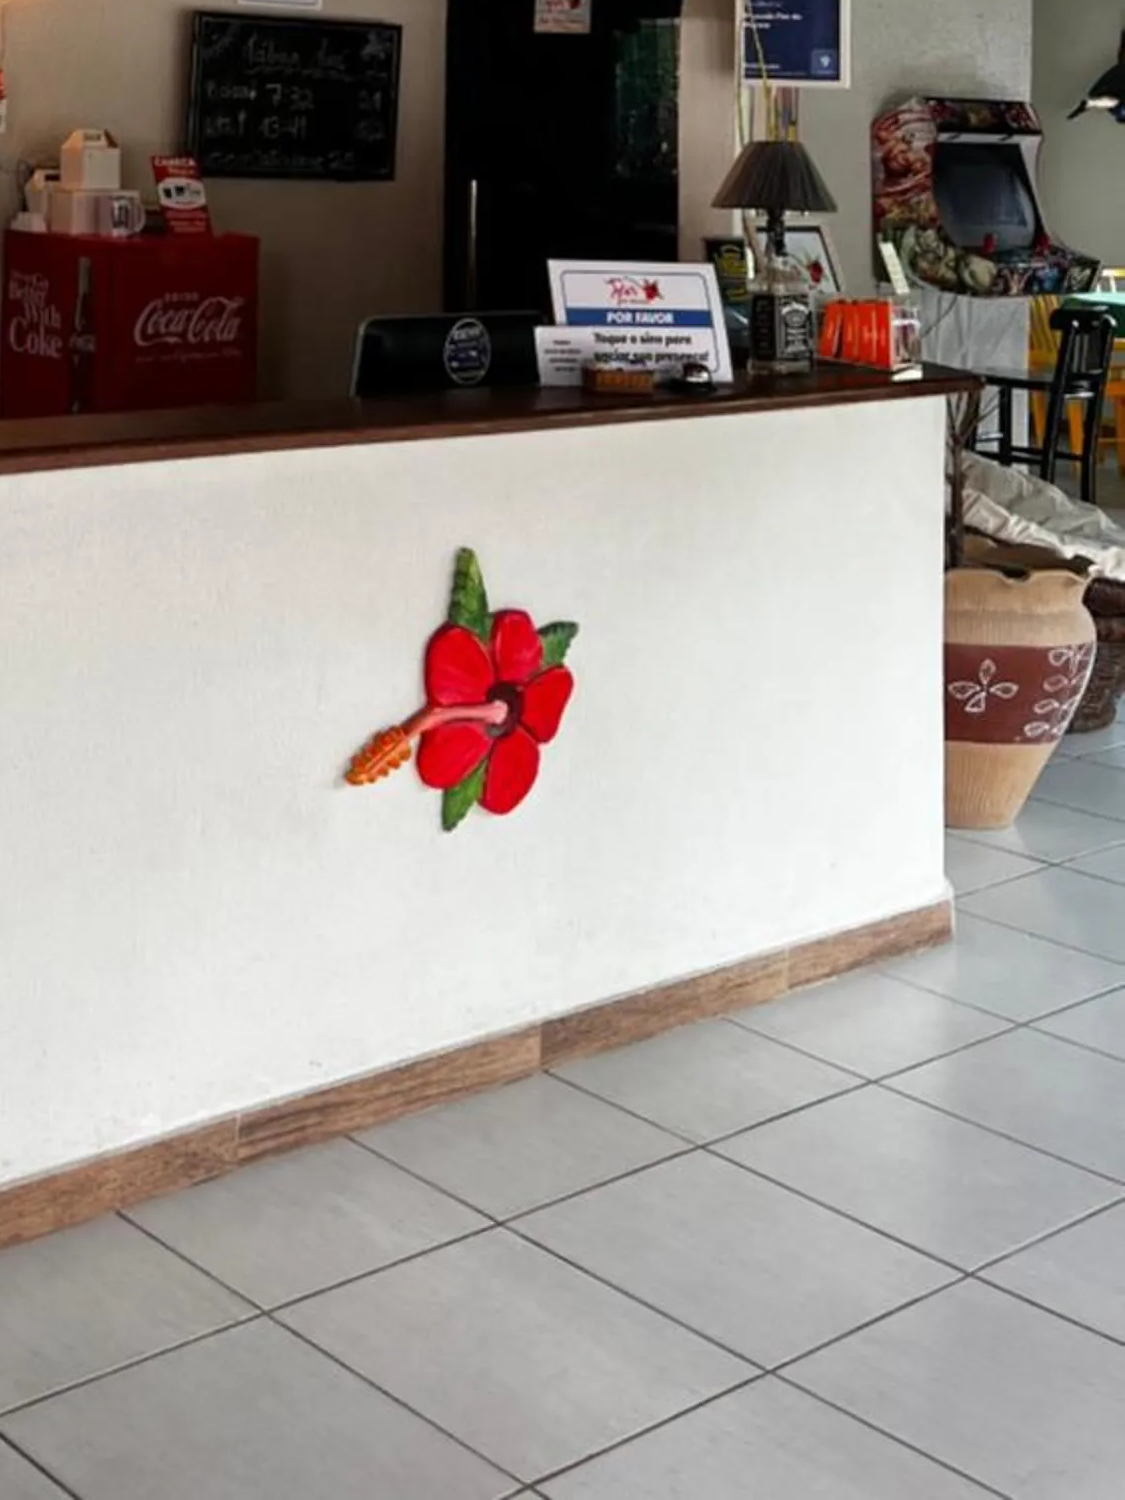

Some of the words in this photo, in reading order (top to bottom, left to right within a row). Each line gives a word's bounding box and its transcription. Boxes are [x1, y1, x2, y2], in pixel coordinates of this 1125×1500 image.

[606, 311, 633, 323] POR
[635, 311, 675, 325] FAVOR
[9, 315, 64, 359] Coke
